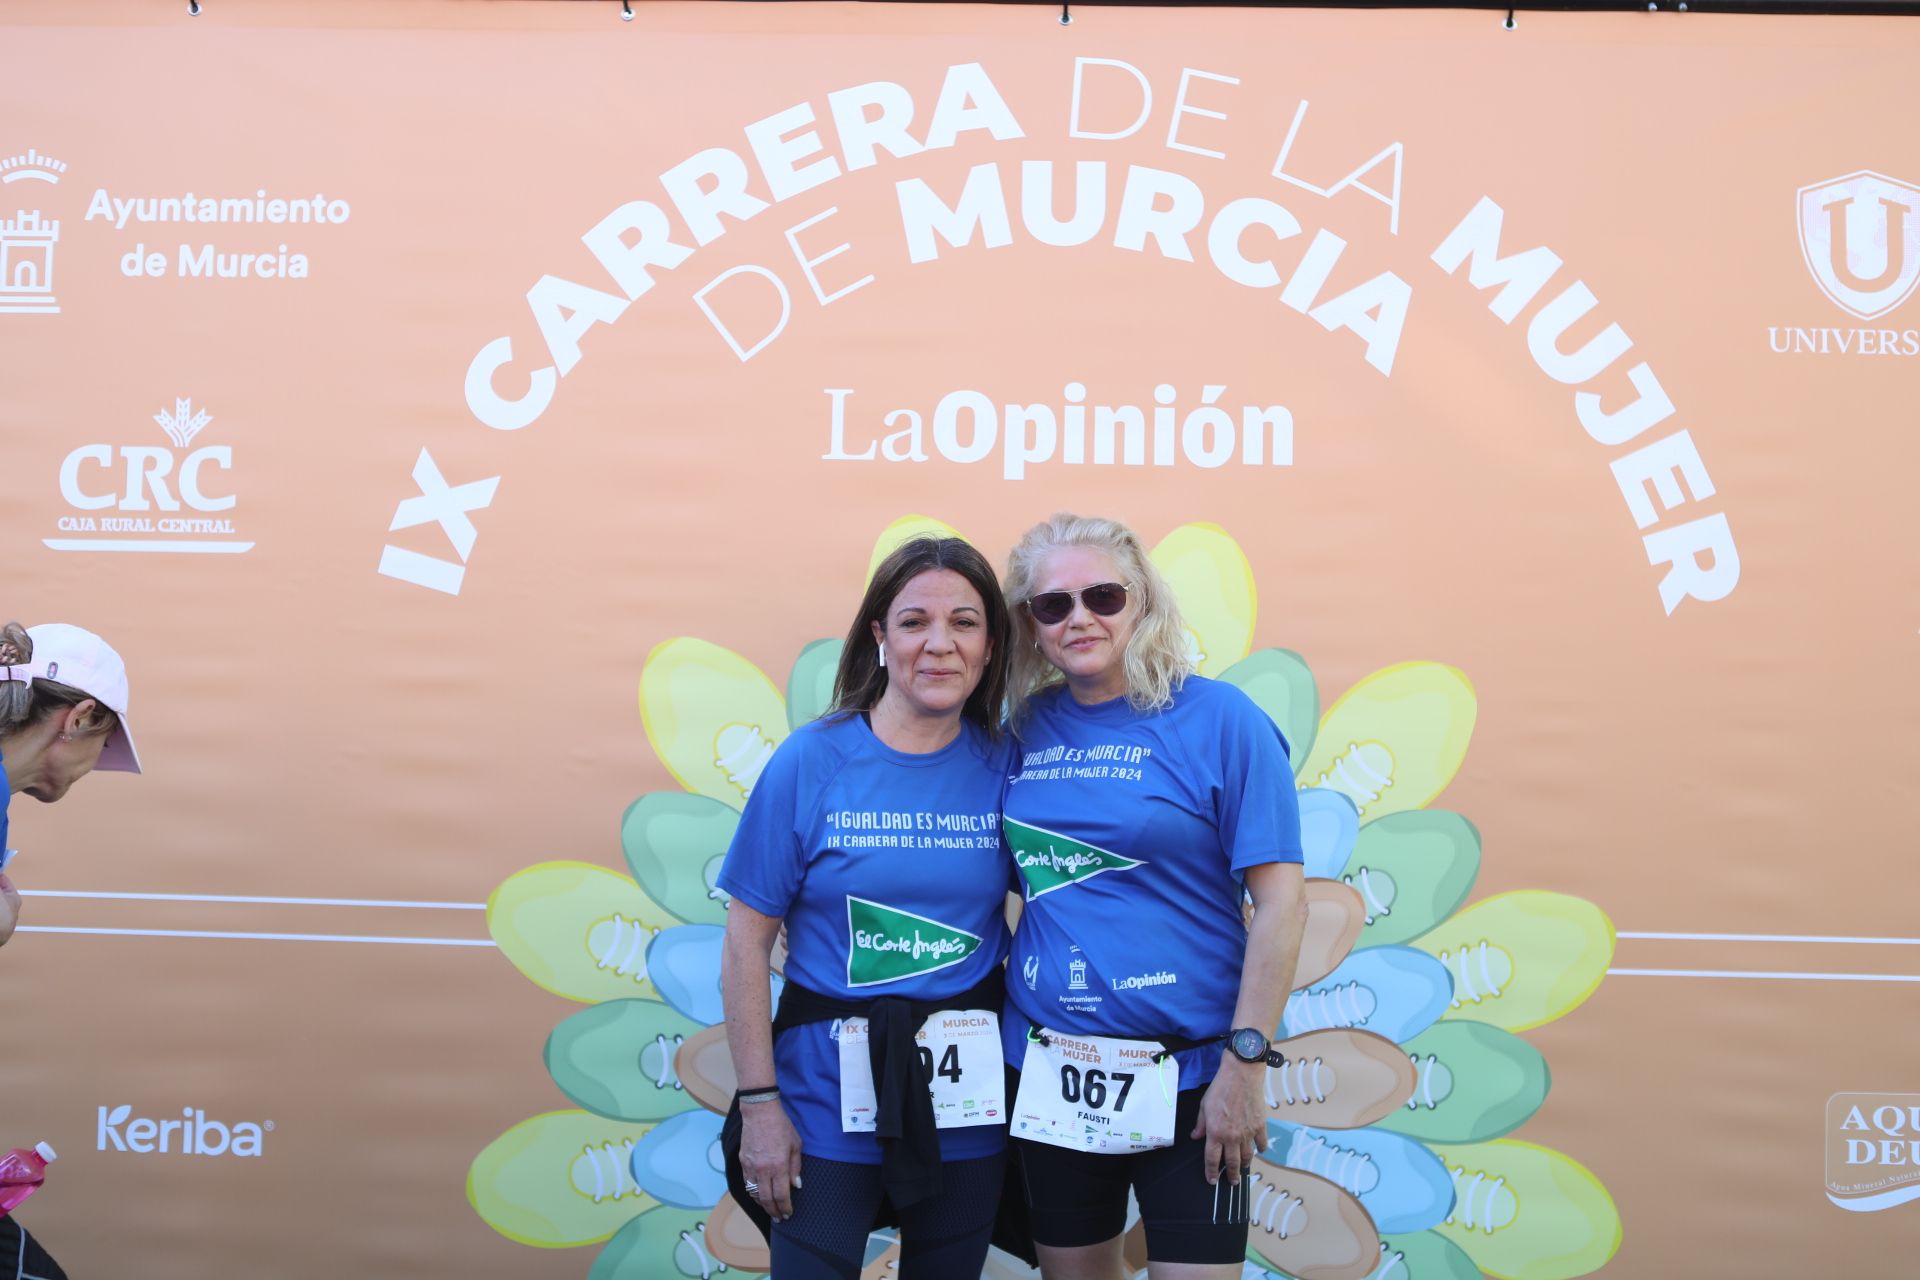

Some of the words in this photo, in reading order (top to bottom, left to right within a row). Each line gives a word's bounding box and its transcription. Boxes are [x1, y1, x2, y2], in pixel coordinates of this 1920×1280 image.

[84, 189, 350, 229] Ayuntamiento
[120, 244, 167, 277] de
[178, 244, 309, 278] Murcia
[692, 206, 874, 363] DE
[895, 160, 1413, 378] MURCIA
[377, 446, 502, 595] IX
[464, 62, 1026, 431] CARRERA
[1068, 56, 1240, 159] DE
[1271, 99, 1404, 235] LA
[1430, 194, 1741, 617] MUJER
[1768, 327, 1920, 356] UNIVERS
[59, 444, 236, 512] CRC
[58, 517, 97, 531] CAJA
[100, 518, 155, 532] RURAL
[158, 518, 235, 533] CENTRAL
[1024, 746, 1065, 766] UALDAD
[1065, 748, 1084, 762] ES
[1049, 768, 1061, 780] DE
[1062, 766, 1073, 779] LA
[1074, 767, 1108, 778] MUJER
[1111, 768, 1142, 781] 2024
[917, 812, 932, 830] ES
[827, 836, 840, 848] IX
[843, 835, 898, 848] CARRERA
[901, 836, 915, 848] DE
[918, 837, 931, 848] LA
[934, 837, 974, 849] MUJER
[977, 837, 1000, 849] 2024
[855, 930, 872, 949] El
[872, 933, 911, 953] Corte
[912, 930, 966, 960] Inglés
[1059, 995, 1102, 1004] Ayuntamiento
[847, 1025, 859, 1035] IX
[943, 1018, 990, 1029] MURCIA
[1048, 1035, 1098, 1054] CARRERA
[1063, 1049, 1102, 1064] MUJER
[1060, 1063, 1135, 1112] 067
[1077, 1111, 1110, 1125] FAUSTI
